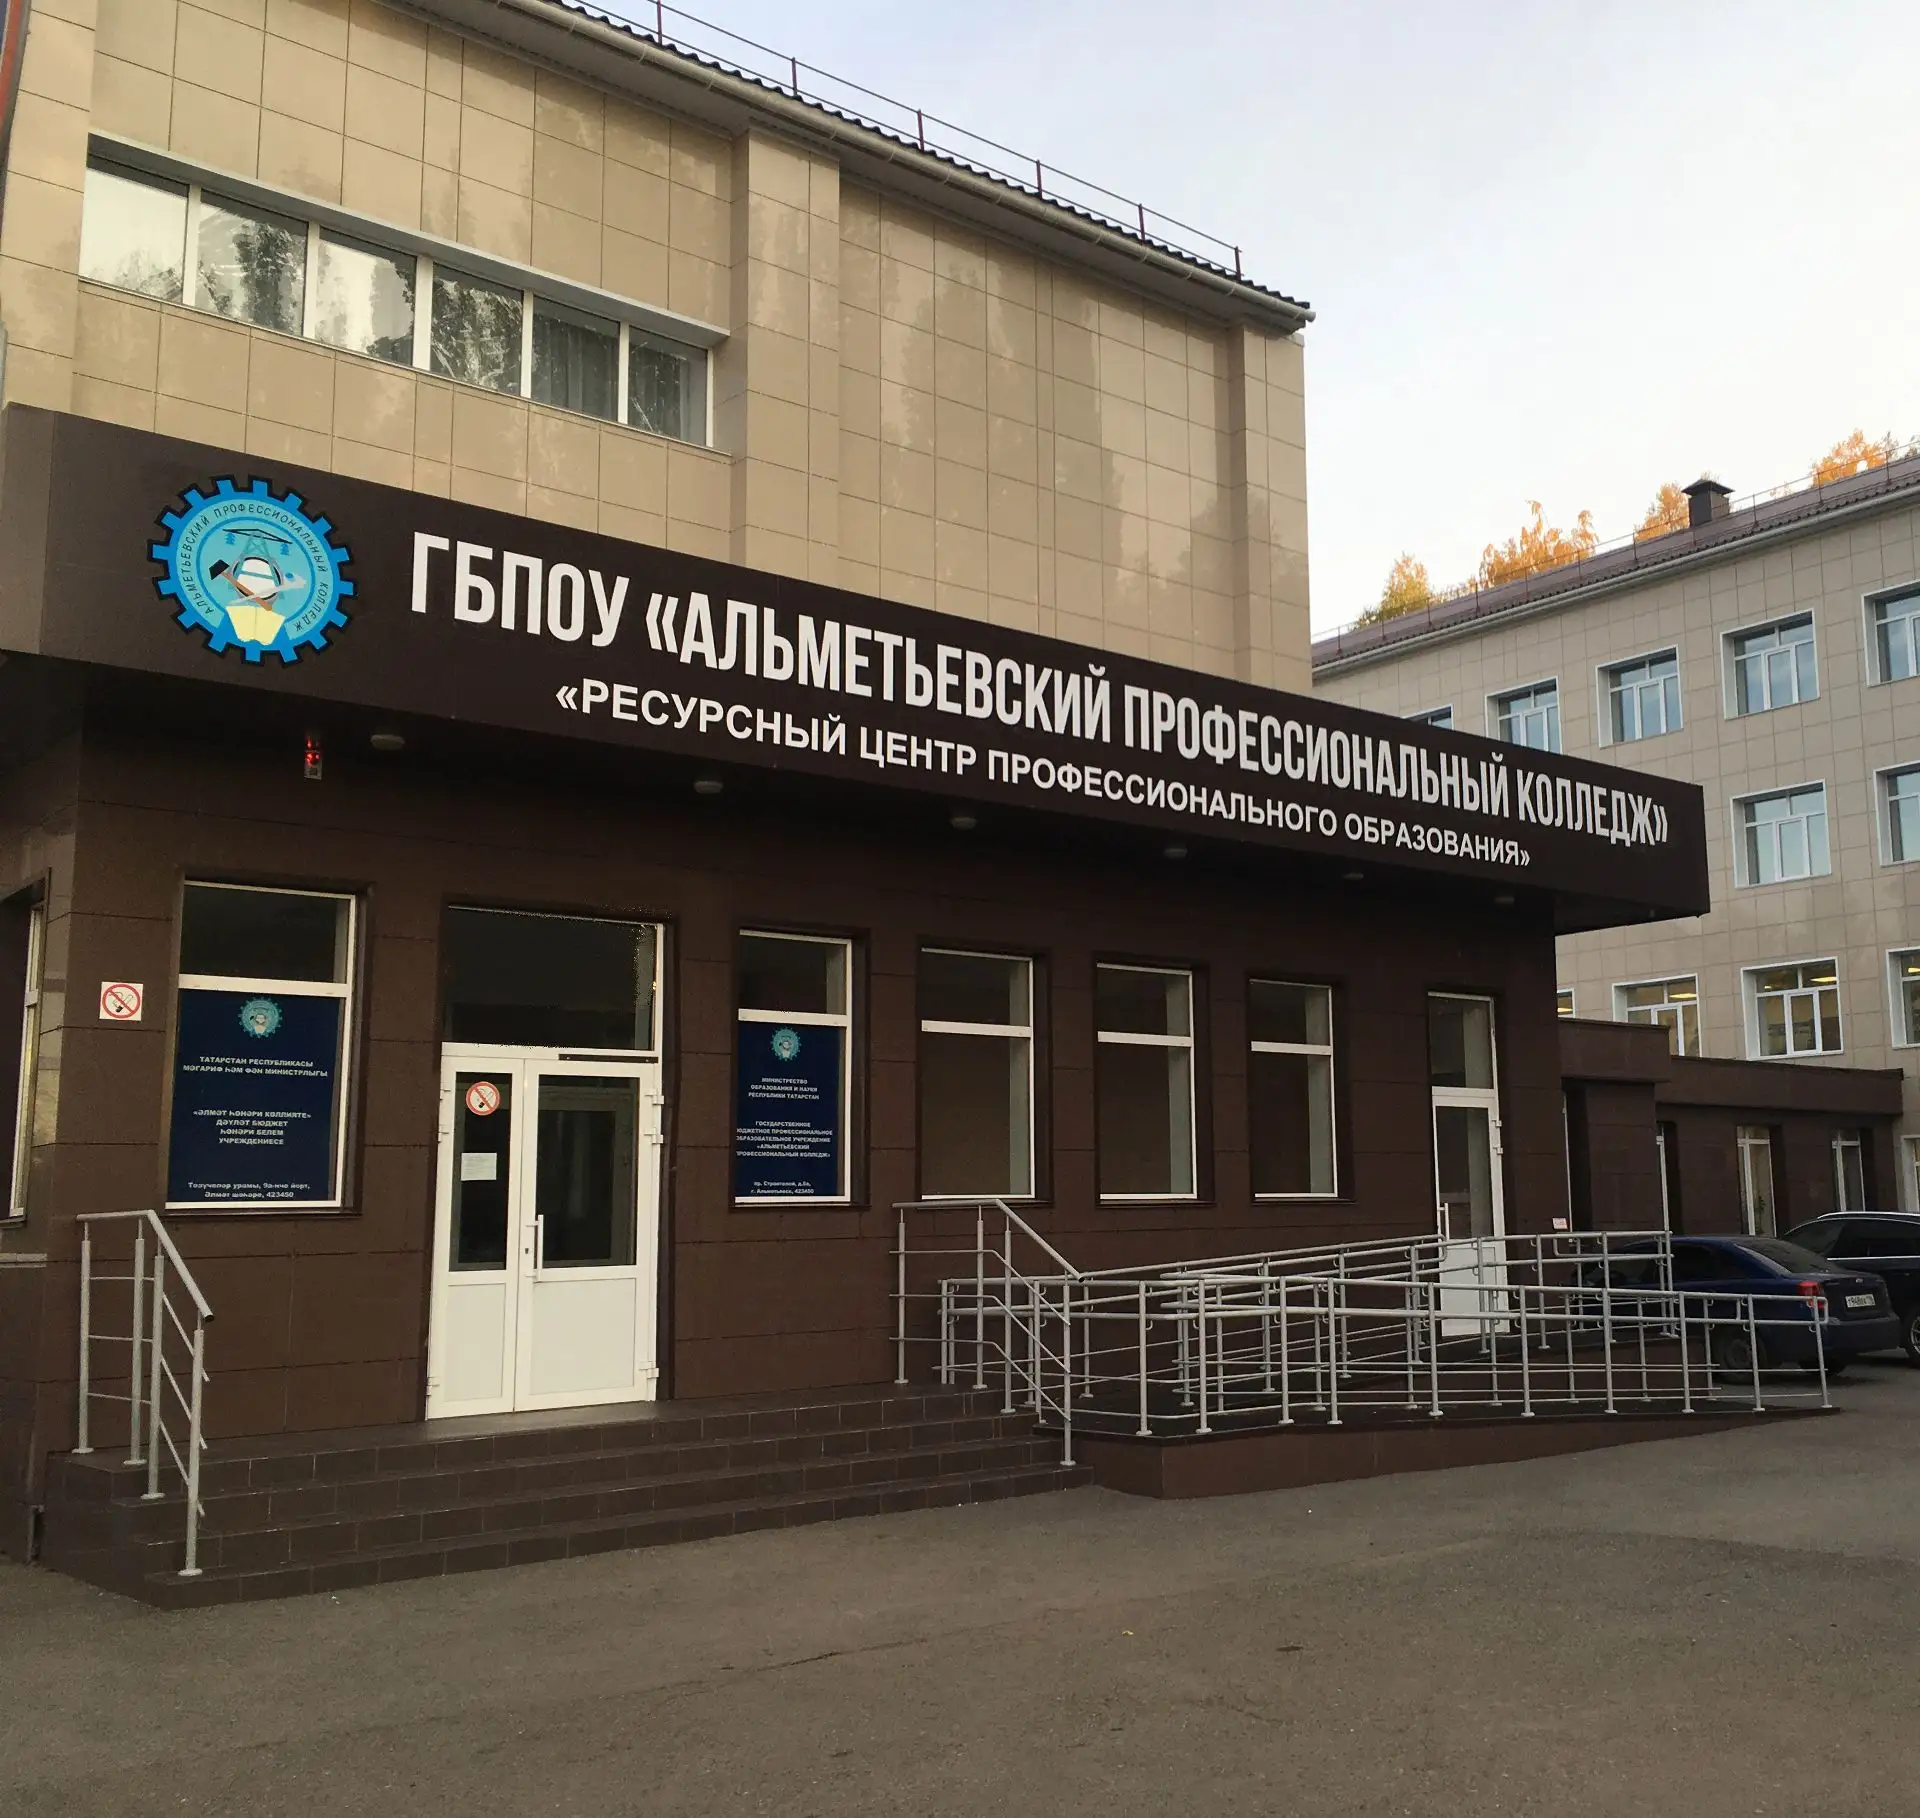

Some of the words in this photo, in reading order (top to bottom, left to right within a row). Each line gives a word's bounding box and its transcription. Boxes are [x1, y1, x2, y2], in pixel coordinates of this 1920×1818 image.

[181, 515, 214, 615] АЛЬМЕТЬЕВСКИЙ
[213, 503, 328, 573] ПРОФЕССИОНАЛЬНЫЙ
[294, 582, 329, 631] КОЛЛЕДЖ
[412, 531, 630, 648] ГБПОУ
[645, 591, 1111, 744] «АЛЬМЕТЬЕВСКИЙ
[1124, 684, 1510, 819] ПРОФЕССИОНАЛЬНЫЙ
[1516, 768, 1669, 848] КОЛЛЕДЖ»
[555, 677, 846, 756] «РЕСУРСНЫЙ
[860, 725, 977, 776] ЦЕНТР
[988, 748, 1338, 837] ПРОФЕССИОНАЛЬНОГО
[1344, 812, 1531, 867] ОБРАЗОВАНИЯ»
[199, 1056, 247, 1065] ТАТАРСТАН
[248, 1058, 313, 1067] РЕСПУБЛИКАСЫ
[265, 1068, 328, 1077] МИНИСТРЛЫГЫ
[251, 1120, 289, 1128] БЮДЖЕТ
